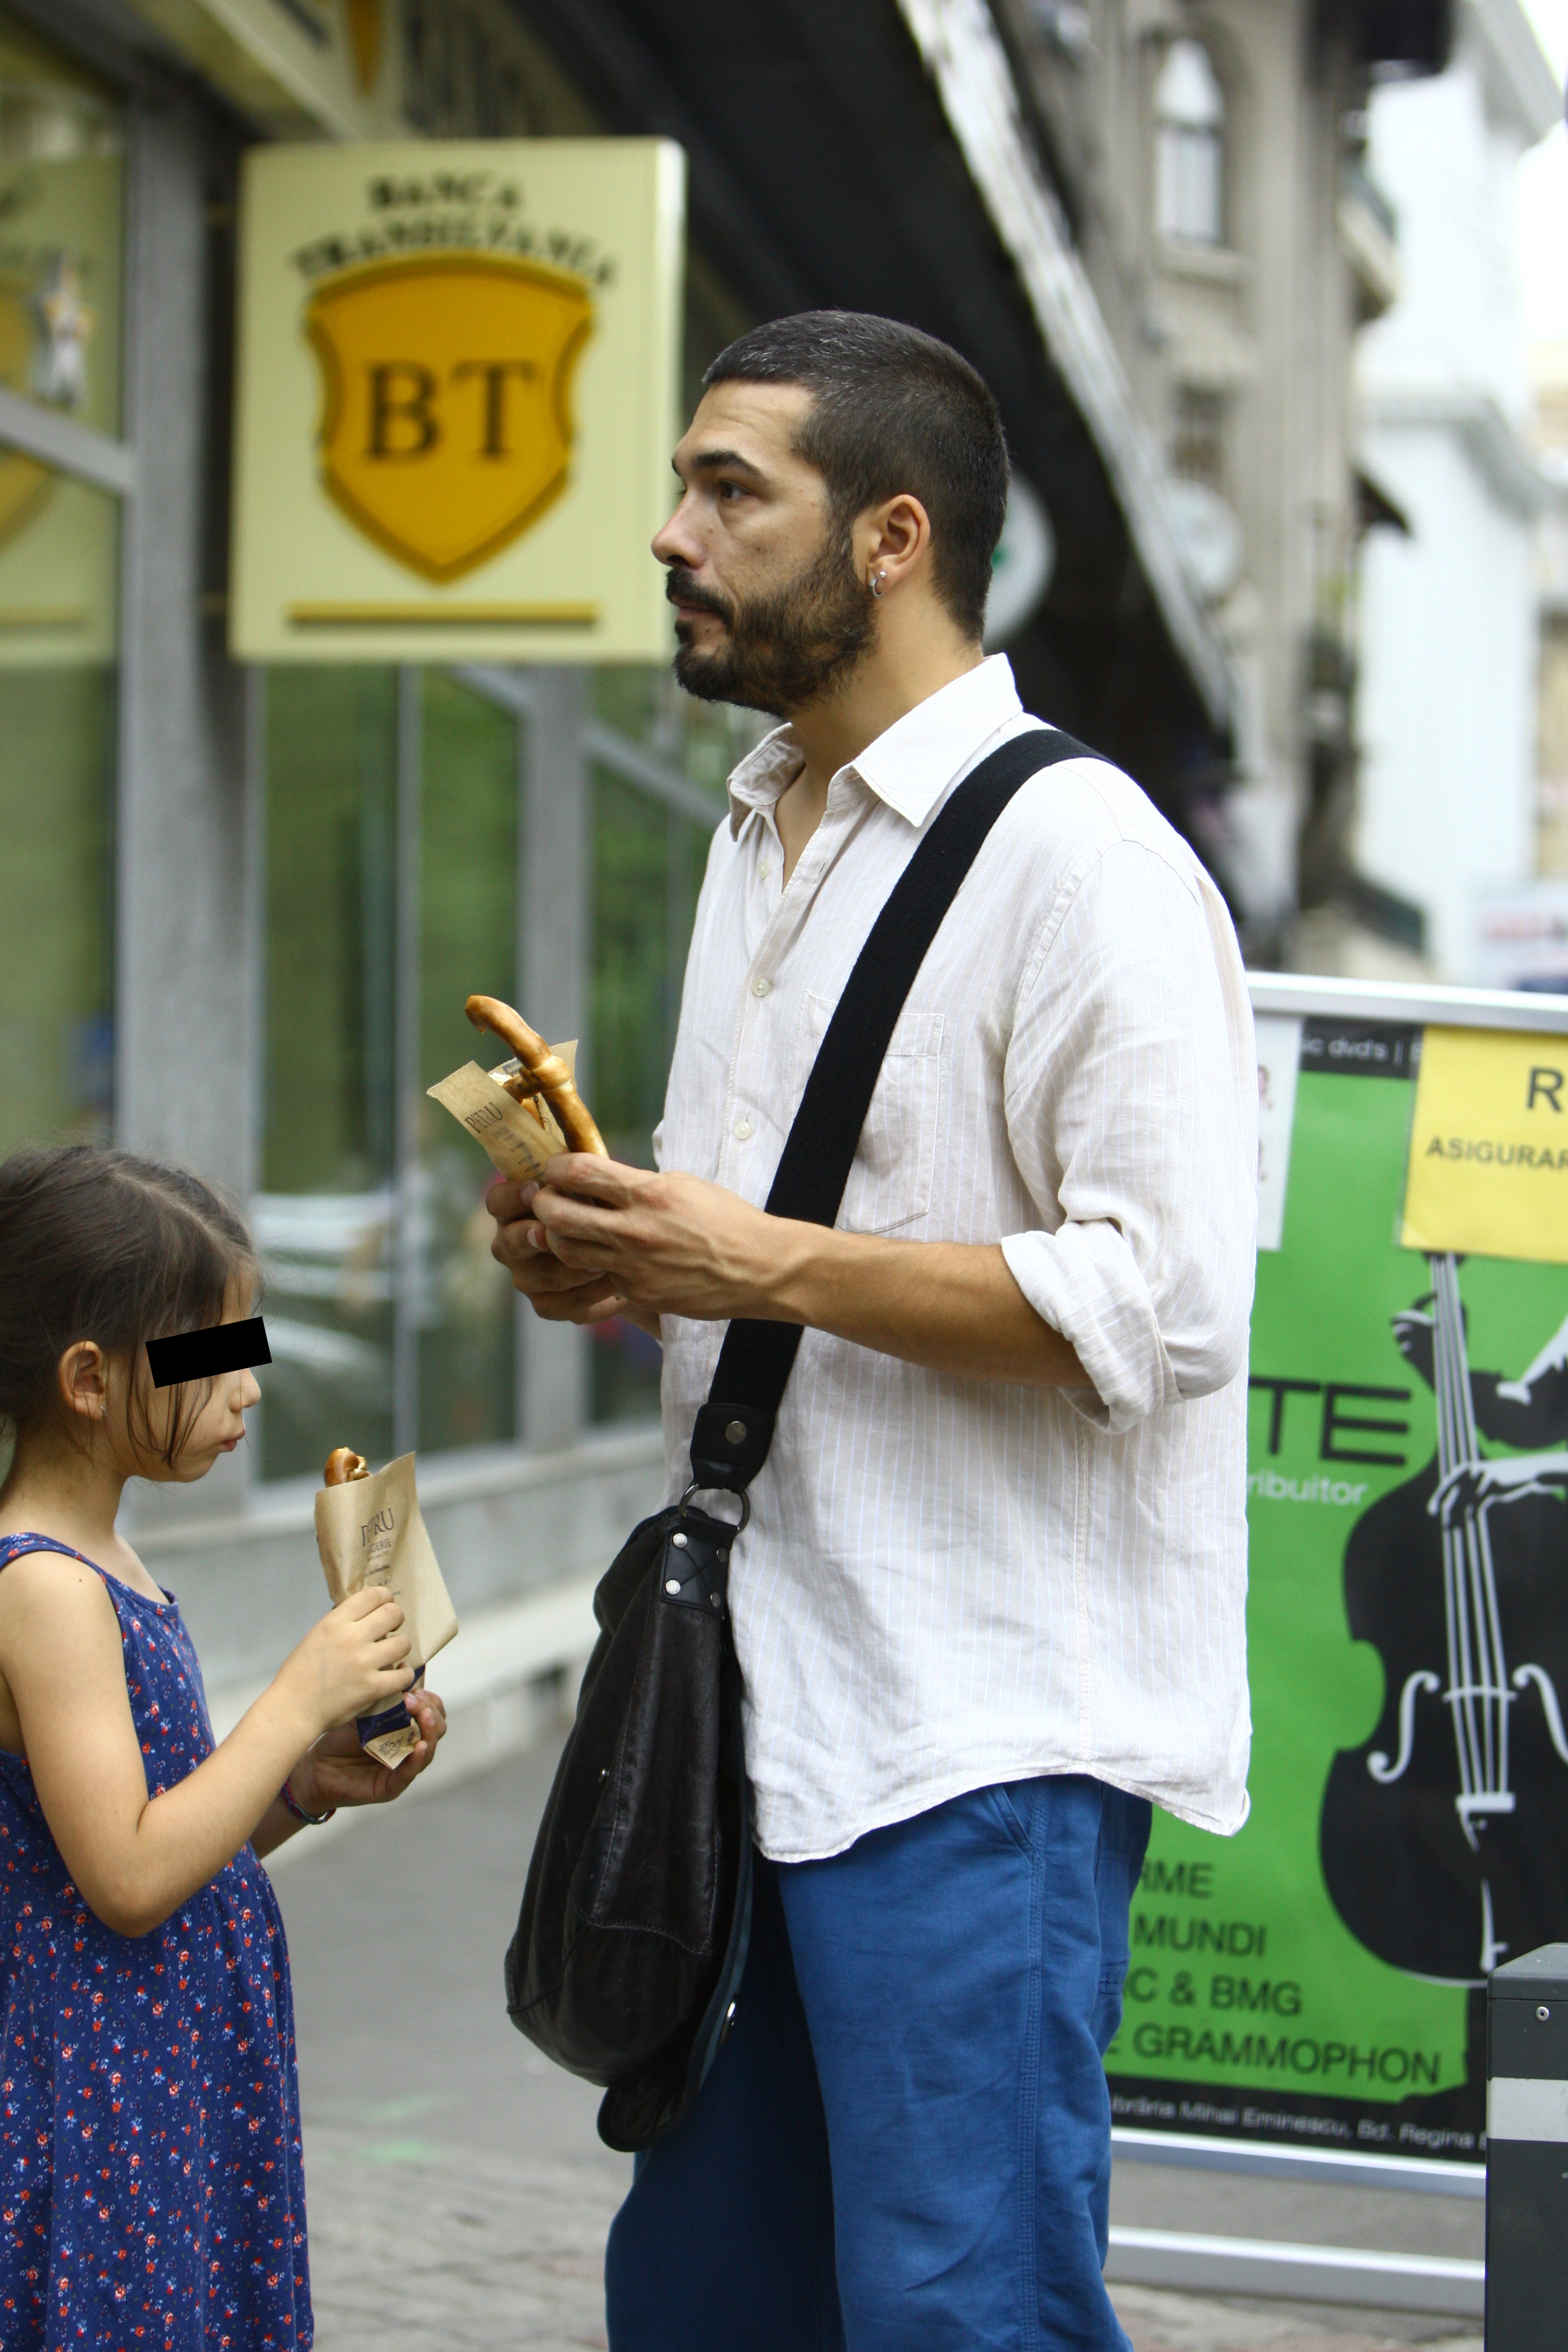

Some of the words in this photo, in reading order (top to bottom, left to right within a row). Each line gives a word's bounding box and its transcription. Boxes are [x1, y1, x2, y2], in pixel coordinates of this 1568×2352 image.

[363, 362, 540, 462] BT
[1134, 1913, 1267, 1958] MUNDI
[1170, 1970, 1194, 2006] &
[1209, 1974, 1302, 2017] BMG
[1132, 2022, 1441, 2085] GRAMMOPHON
[1399, 2122, 1475, 2150] Regina
